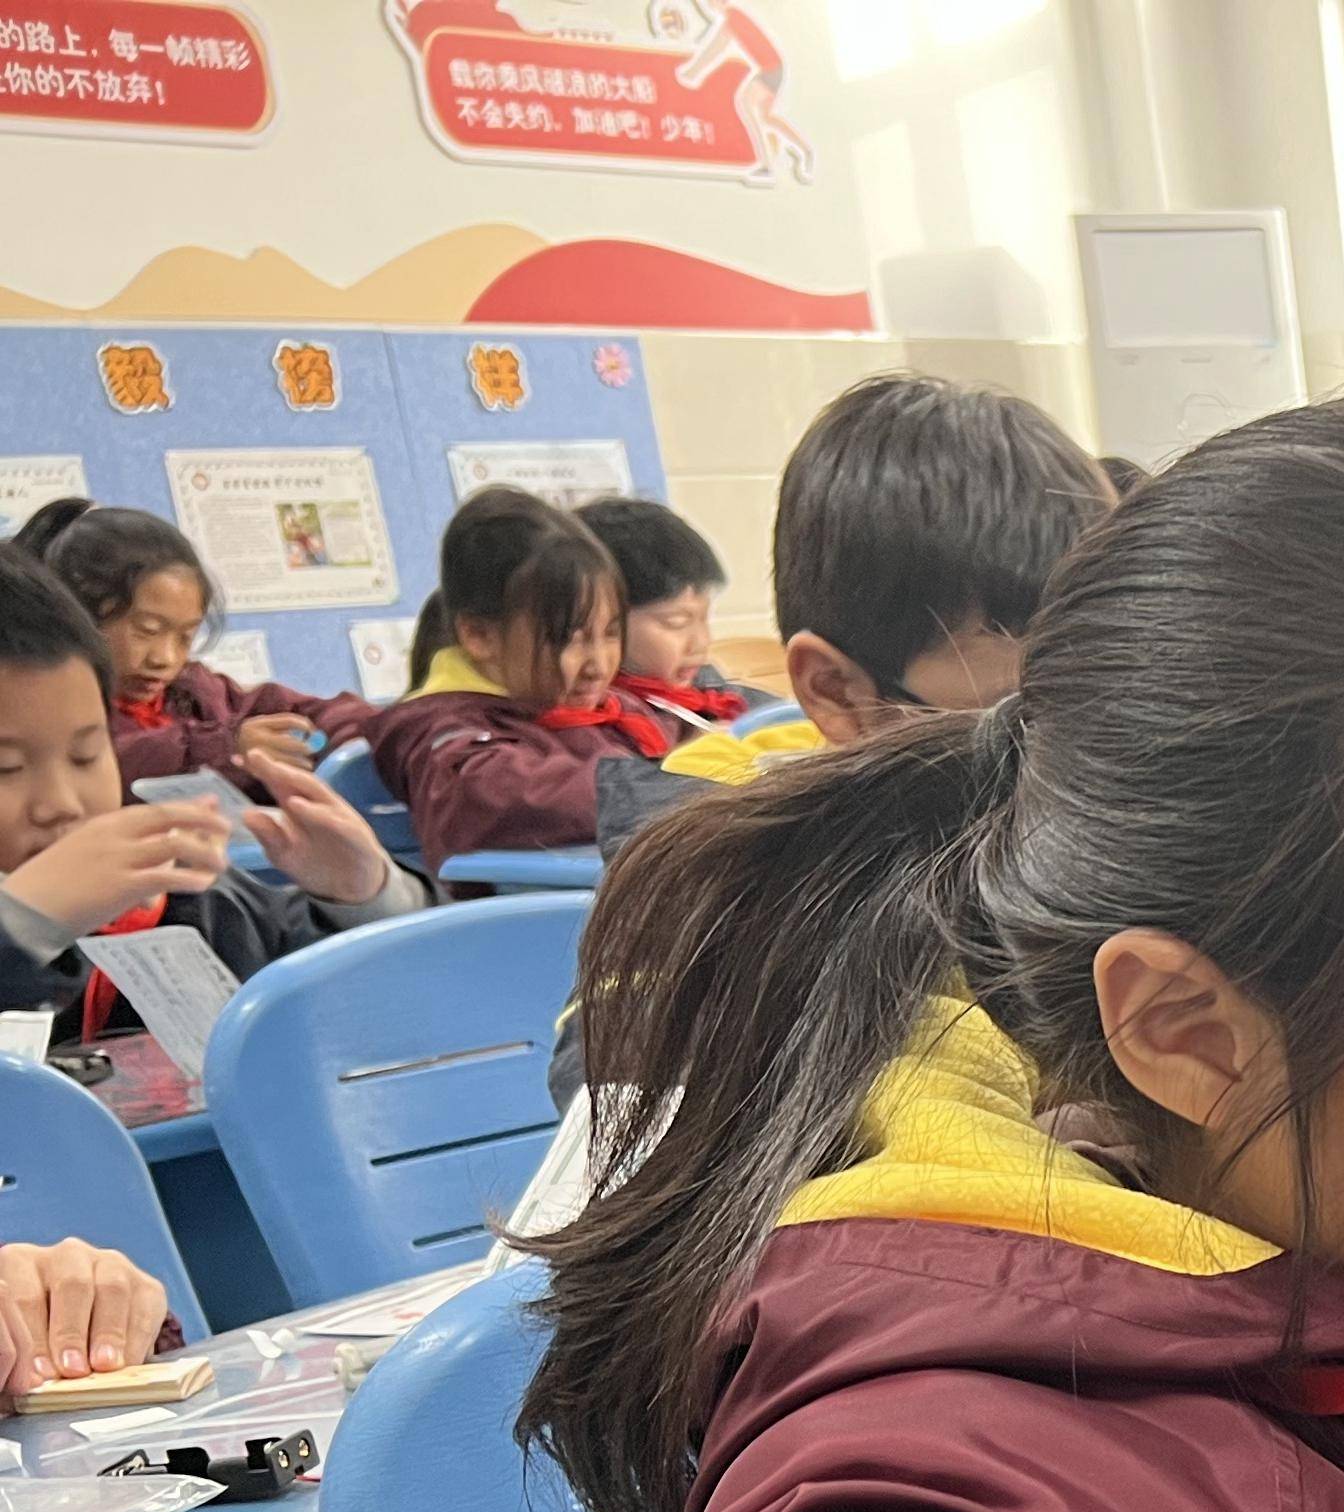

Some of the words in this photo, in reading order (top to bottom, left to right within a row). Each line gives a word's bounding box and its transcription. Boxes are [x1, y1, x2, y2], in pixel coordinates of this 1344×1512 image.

[0, 62, 166, 105] 你的不放弃！
